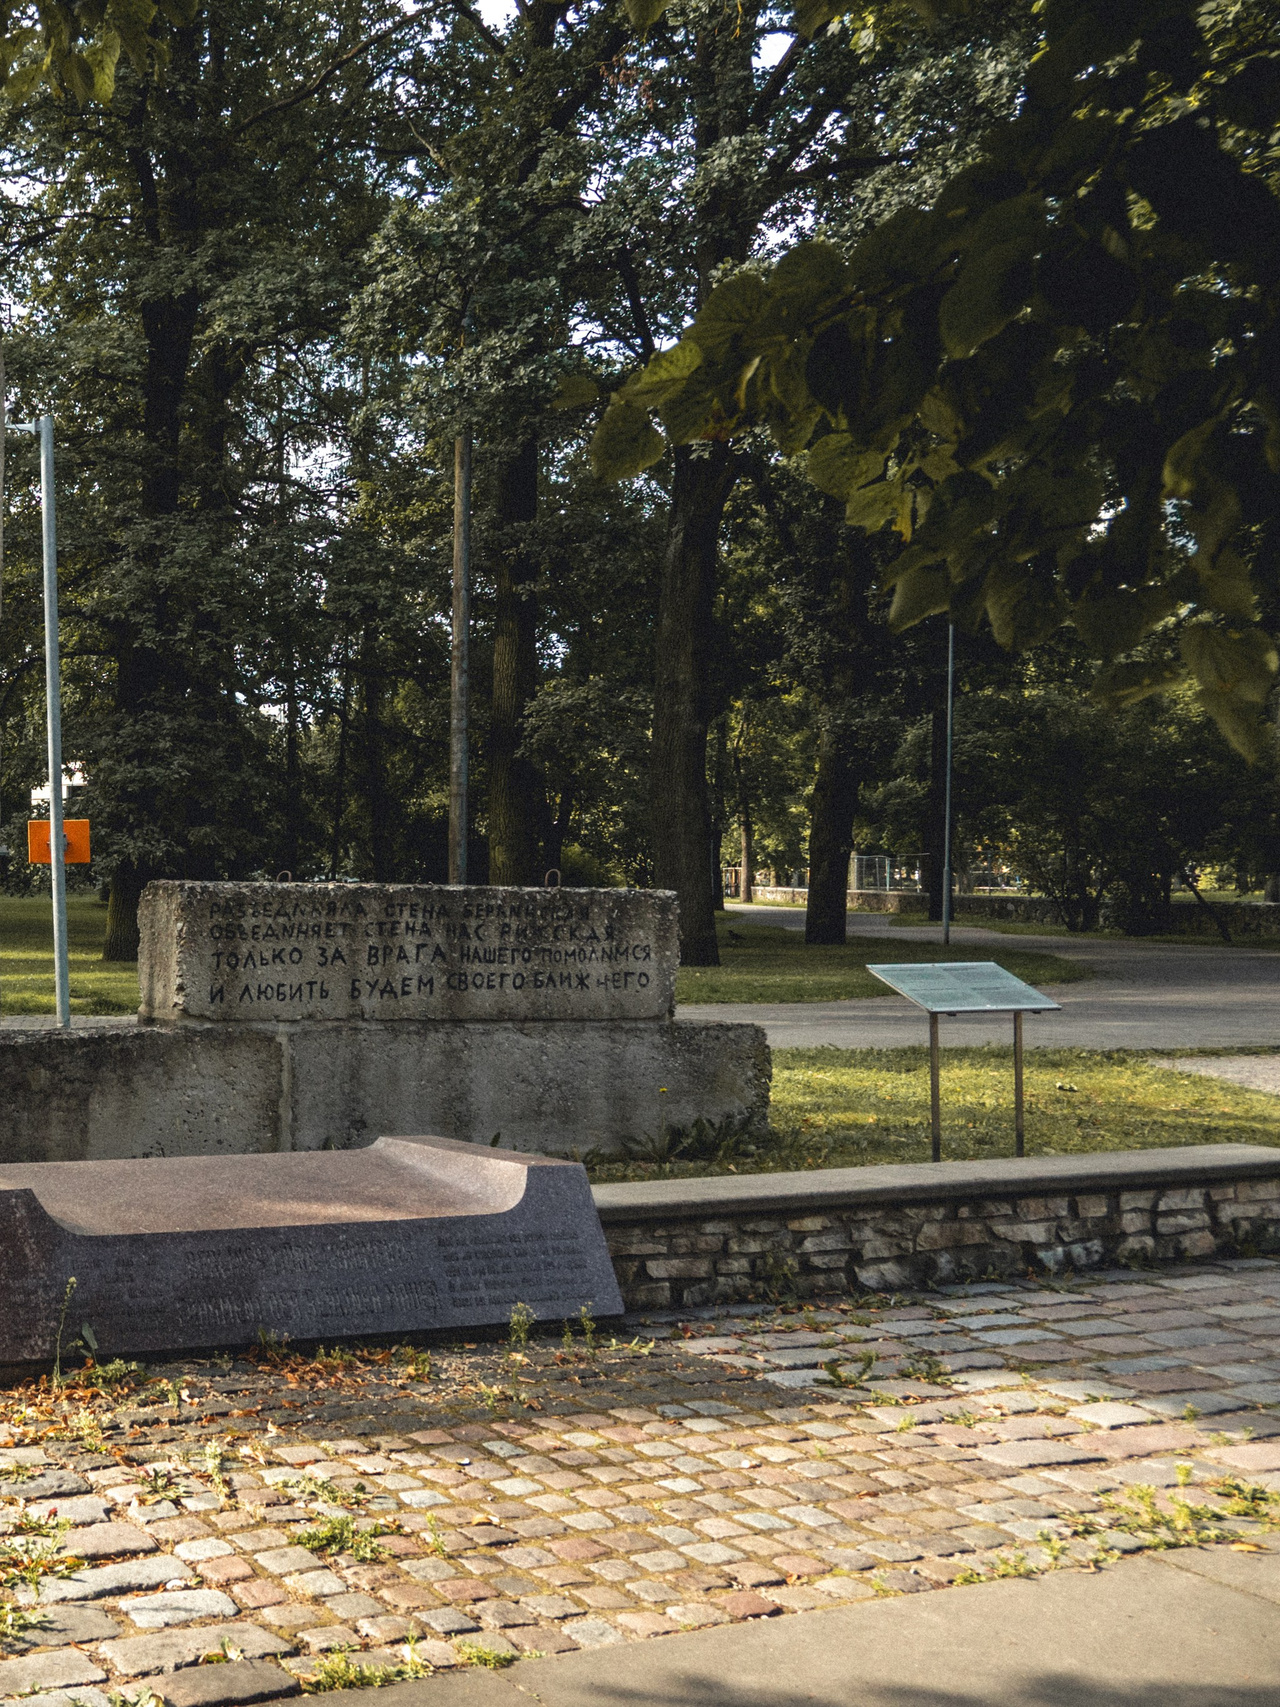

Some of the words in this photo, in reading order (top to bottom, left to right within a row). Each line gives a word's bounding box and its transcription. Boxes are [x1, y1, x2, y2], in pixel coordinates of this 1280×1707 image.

[384, 902, 450, 920] СТЕНА
[365, 920, 431, 938] СТЕНА
[446, 922, 485, 941] НАС
[212, 947, 303, 971] ТОЛЬКО
[317, 947, 347, 967] ЗА
[367, 943, 447, 967] ВРАГА
[460, 944, 531, 965] НАШЕГО
[540, 944, 651, 966] ПОМОЛИМСЯ
[209, 984, 224, 1004] И
[239, 980, 329, 1003] ЛЮБИТЬ
[350, 974, 434, 1000] БУДЕМ
[446, 971, 525, 991] СВОЕГО
